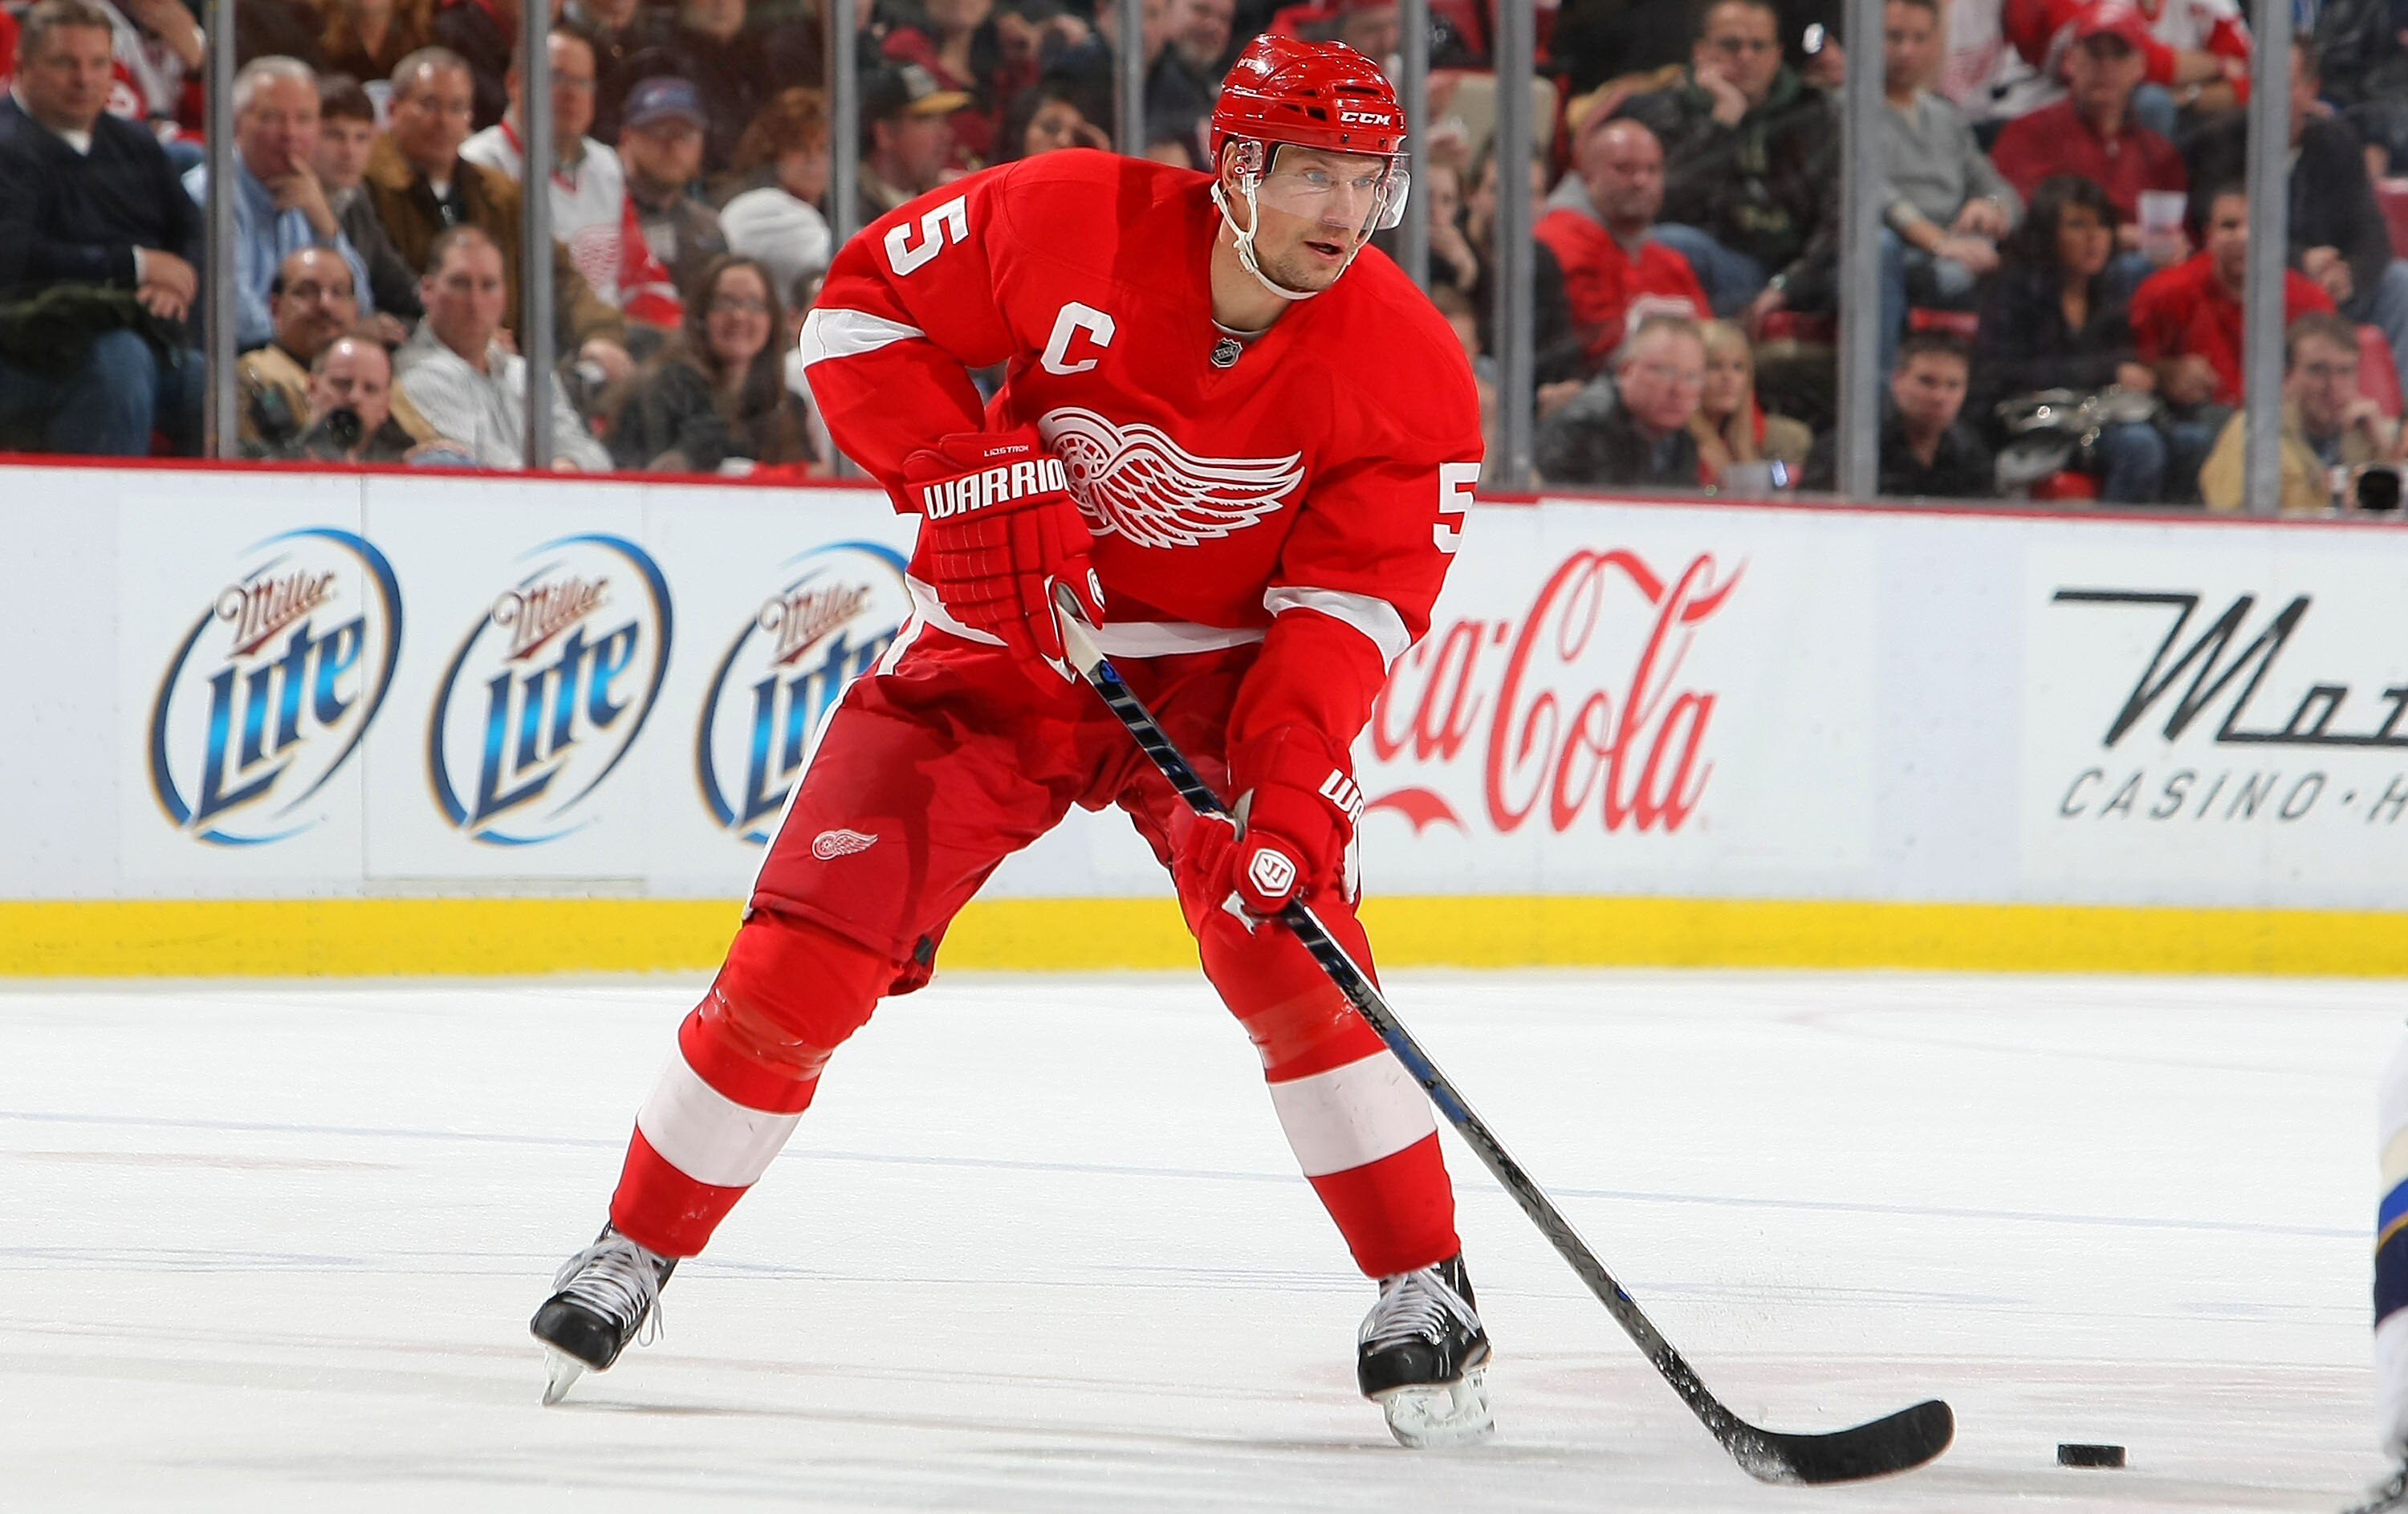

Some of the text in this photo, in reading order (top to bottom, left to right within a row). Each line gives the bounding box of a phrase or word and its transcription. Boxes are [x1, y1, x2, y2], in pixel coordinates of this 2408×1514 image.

[1340, 111, 1391, 126] CCM
[884, 194, 970, 276] 5
[1040, 301, 1116, 375] C
[923, 458, 1071, 520] WARRIO
[1432, 462, 1482, 553] 5
[213, 570, 337, 658] Miller
[488, 576, 610, 661] Miller
[756, 584, 872, 667] Miller
[189, 615, 367, 830] Lite
[468, 618, 641, 831] Lite
[2060, 767, 2327, 820] CASINO
